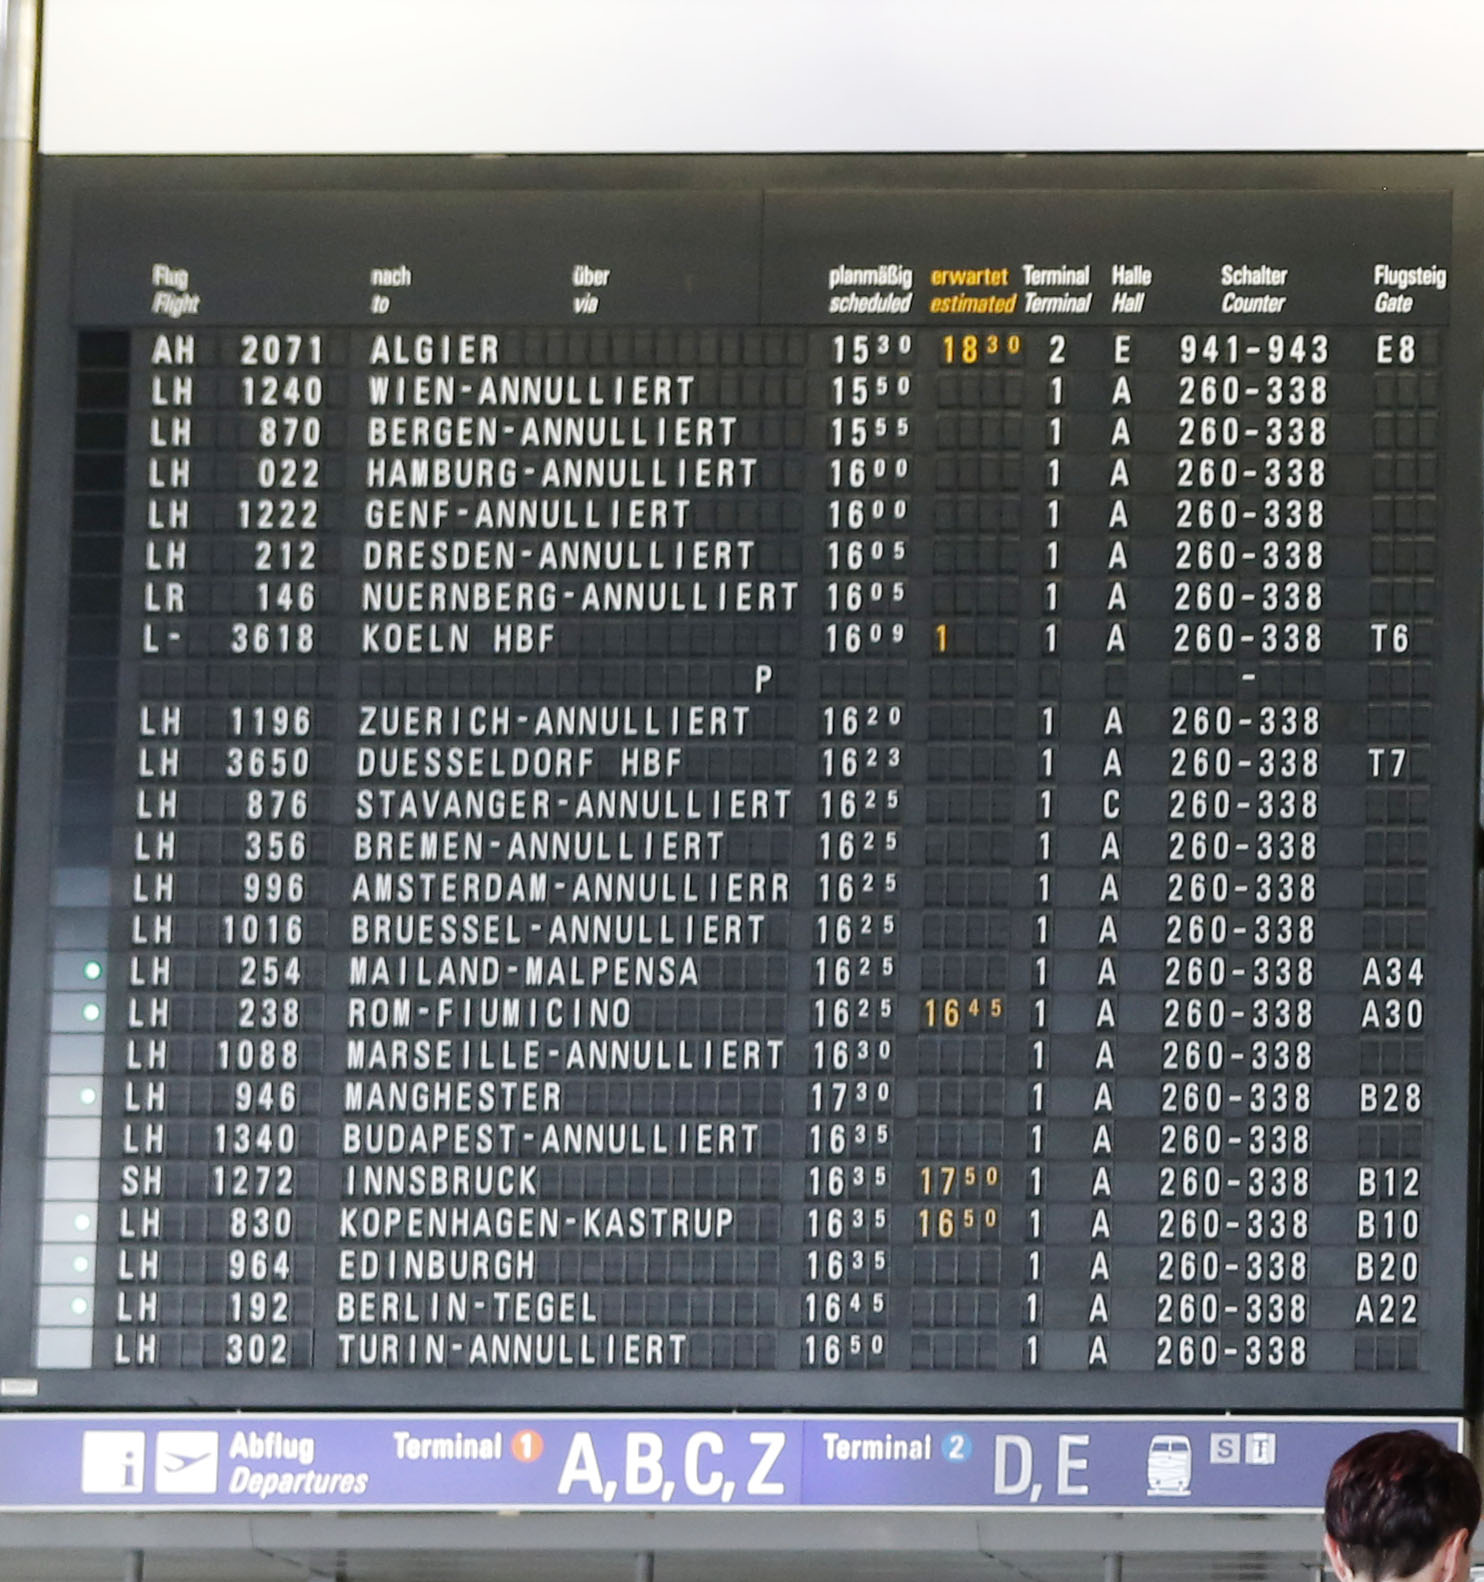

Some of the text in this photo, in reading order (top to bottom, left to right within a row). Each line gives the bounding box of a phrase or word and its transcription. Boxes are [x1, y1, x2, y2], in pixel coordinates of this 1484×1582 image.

[151, 334, 1415, 365] AH 2071 ALGIER 941-943 E8
[369, 375, 695, 406] WIEN-ANNULLIERT
[368, 416, 737, 447] BERGEN-ANNULLIERT
[362, 581, 798, 612] NUERNBERG-ANNULLIERT
[359, 705, 750, 736] ZUERICH-ANNULLIERT
[139, 747, 1406, 777] LH 3650 DUESSELDORF HBF 260-338 T7
[352, 914, 765, 944] BRUESSEL-ANNULLIERT
[350, 955, 698, 986] MAILAND-MALPENSA
[349, 997, 630, 1028] ROM-FIUMICINO
[344, 1123, 758, 1154] BUDAPEST-ANNULLIERT
[122, 1165, 1419, 1197] SH 1272 INNSBRUCK 260-338 B12
[340, 1207, 733, 1238] KOPENHAGEN-KASTRUP
[340, 1249, 534, 1280] EDINBURGH
[337, 1291, 596, 1322] BERLIN-TEGEL
[230, 1432, 313, 1464] Abflug
[394, 1432, 501, 1459] Terminal
[520, 1432, 532, 1459] 1
[823, 1433, 931, 1460] Terminal
[949, 1434, 965, 1459] 2
[1217, 1438, 1233, 1458] S
[229, 1467, 368, 1499] Departures
